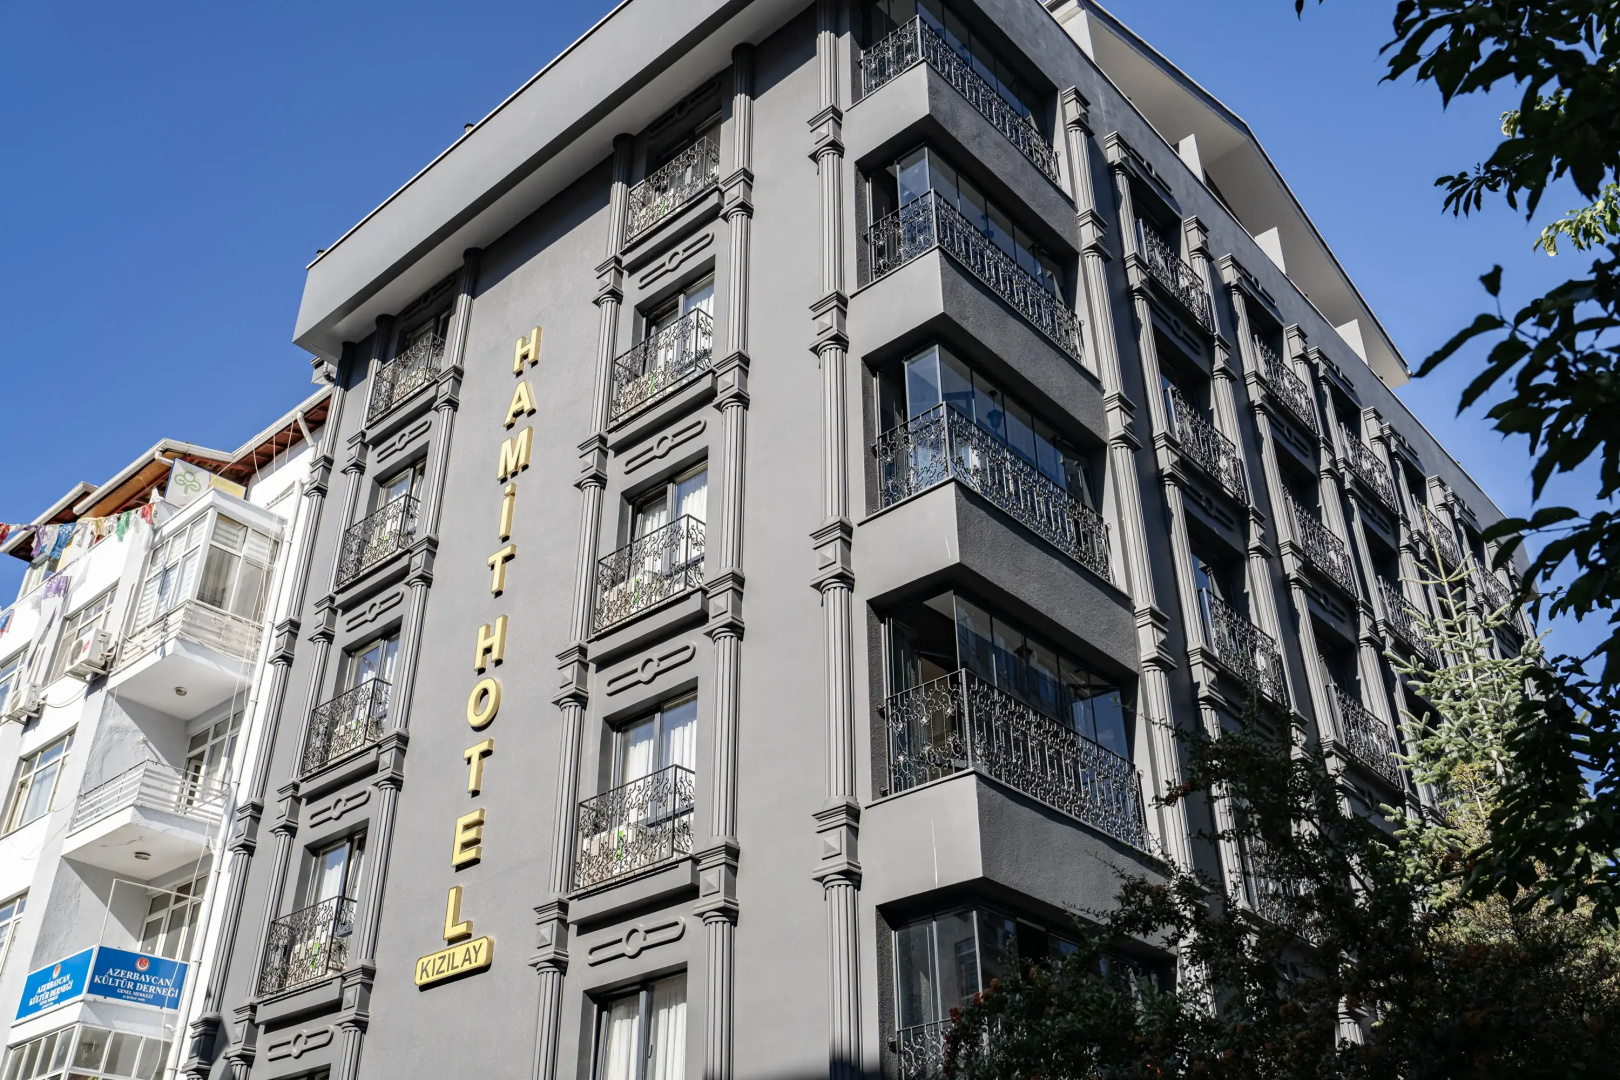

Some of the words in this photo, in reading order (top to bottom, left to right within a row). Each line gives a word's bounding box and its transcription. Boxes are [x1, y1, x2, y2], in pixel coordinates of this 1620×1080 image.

[443, 614, 509, 941] HOTEL
[106, 967, 173, 986] AZERBAYCAN
[420, 943, 483, 980] KIZILAY
[93, 974, 134, 990] KÜLTÜR
[135, 982, 179, 998] DERNEĞİ
